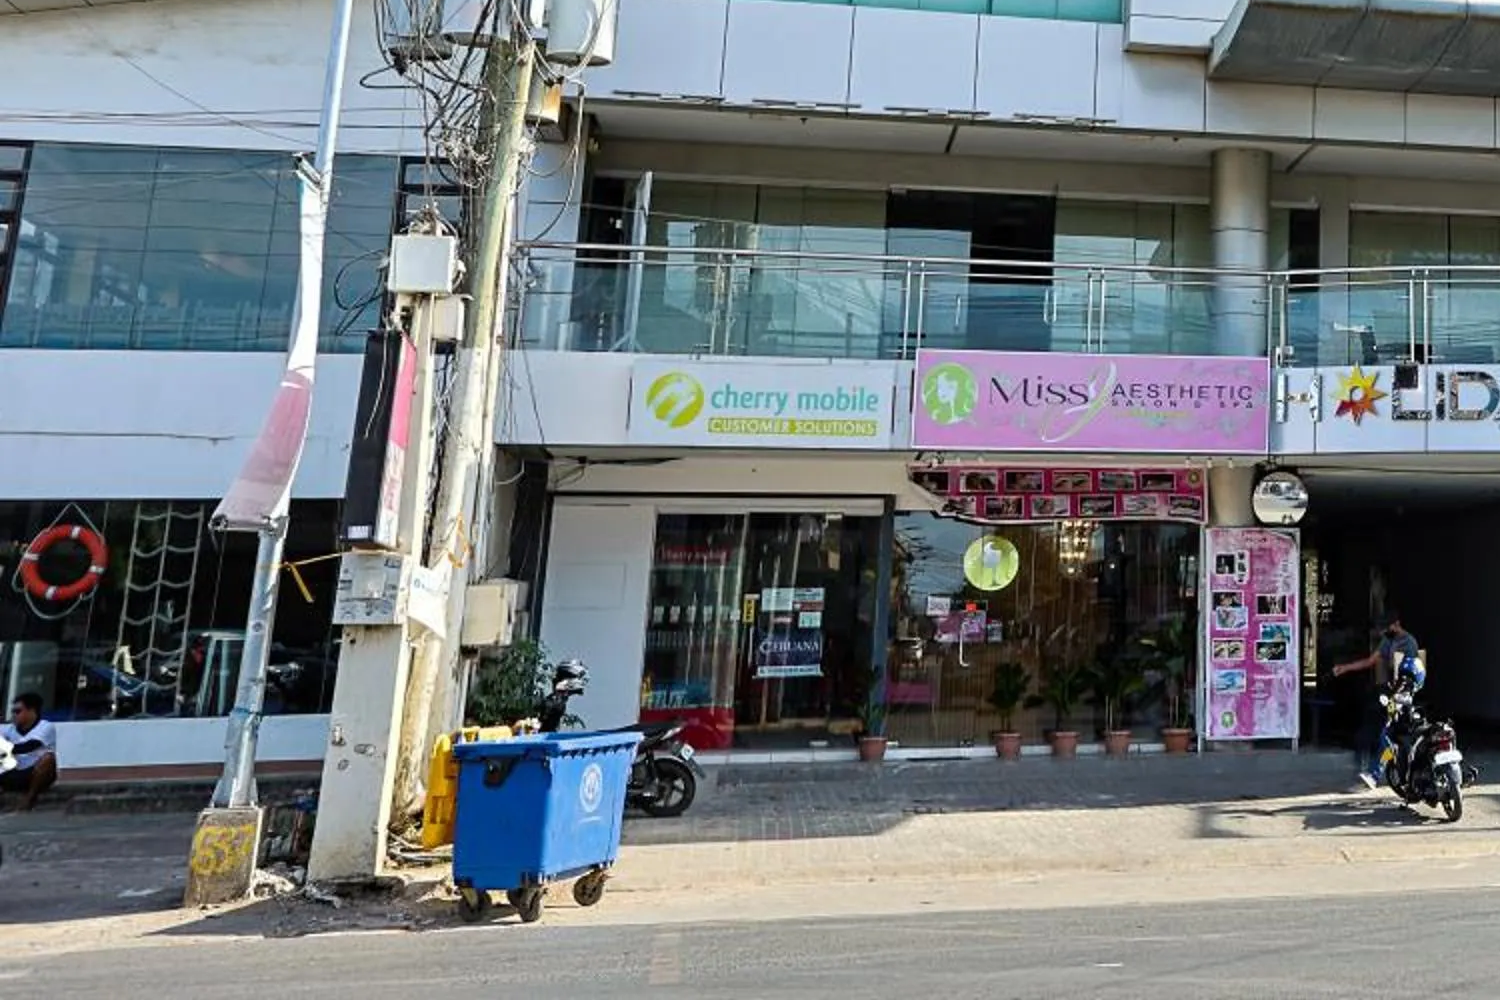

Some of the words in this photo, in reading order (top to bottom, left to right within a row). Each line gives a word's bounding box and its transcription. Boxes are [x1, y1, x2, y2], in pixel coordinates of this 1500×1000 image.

[711, 384, 789, 416] cherry
[798, 386, 879, 412] mobile
[1111, 382, 1254, 402] AESTHETIC
[711, 419, 790, 435] CUSTOMER
[796, 421, 876, 436] SOLUTIONS
